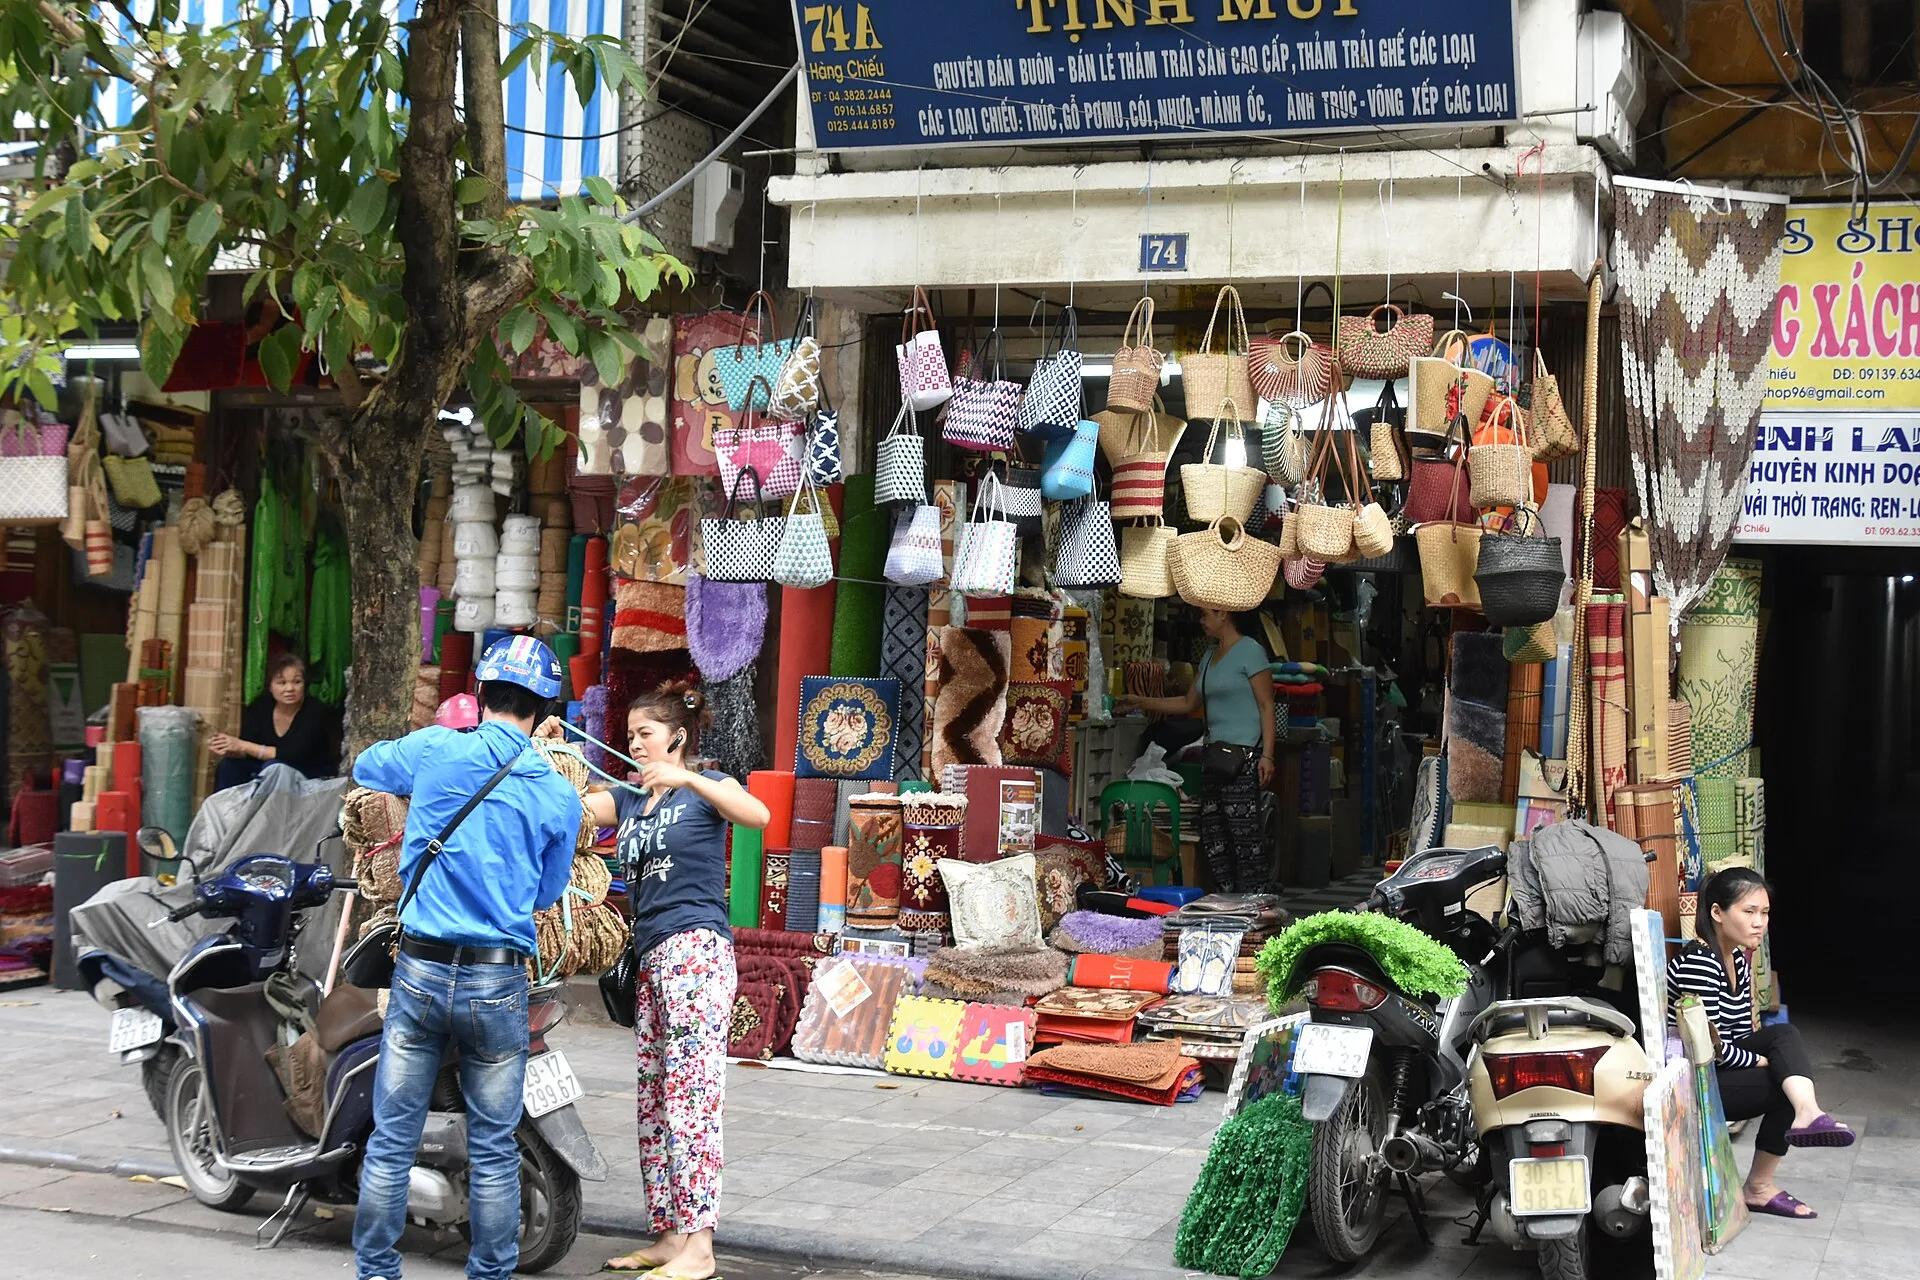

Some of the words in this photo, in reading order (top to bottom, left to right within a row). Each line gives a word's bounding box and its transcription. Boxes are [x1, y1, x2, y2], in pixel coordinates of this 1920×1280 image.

[804, 3, 883, 52] 74A
[809, 62, 843, 84] Hàng
[847, 54, 885, 78] Chiếu
[933, 55, 985, 90] CHUYÊN
[987, 54, 1015, 87] BÁN
[1019, 52, 1055, 86] BUÔN
[1068, 48, 1097, 83] BÁN
[1099, 42, 1116, 81] LẺ
[1118, 41, 1157, 81] THẢM
[1161, 38, 1194, 78] TRẢI
[1231, 45, 1258, 75] CAO
[1296, 30, 1337, 71] THẢM
[1342, 28, 1375, 69] TRẢI
[1379, 28, 1405, 67] GHẾ
[1410, 30, 1437, 66] CÁC
[1442, 34, 1476, 70] LOẠI
[829, 89, 892, 102] 04.3828.2444
[834, 104, 894, 117] 0916.14.6857
[919, 104, 945, 137] CÁC
[948, 107, 978, 140] LOẠI
[1411, 78, 1439, 116] XẾP
[1444, 80, 1472, 115] CÁC
[1476, 83, 1508, 118] LOẠI
[827, 118, 896, 132] 0125.444.8189
[1837, 217, 1920, 254] SH
[1149, 240, 1178, 265] 74
[1766, 367, 1796, 380] hiếu
[1852, 427, 1920, 452] LA
[1825, 463, 1875, 486] KINH
[1744, 489, 1767, 518] VẢI
[1772, 491, 1806, 519] THỜI
[1744, 524, 1770, 533] Chiếu
[527, 1075, 576, 1113] 299.67
[1523, 1187, 1577, 1210] 9854
